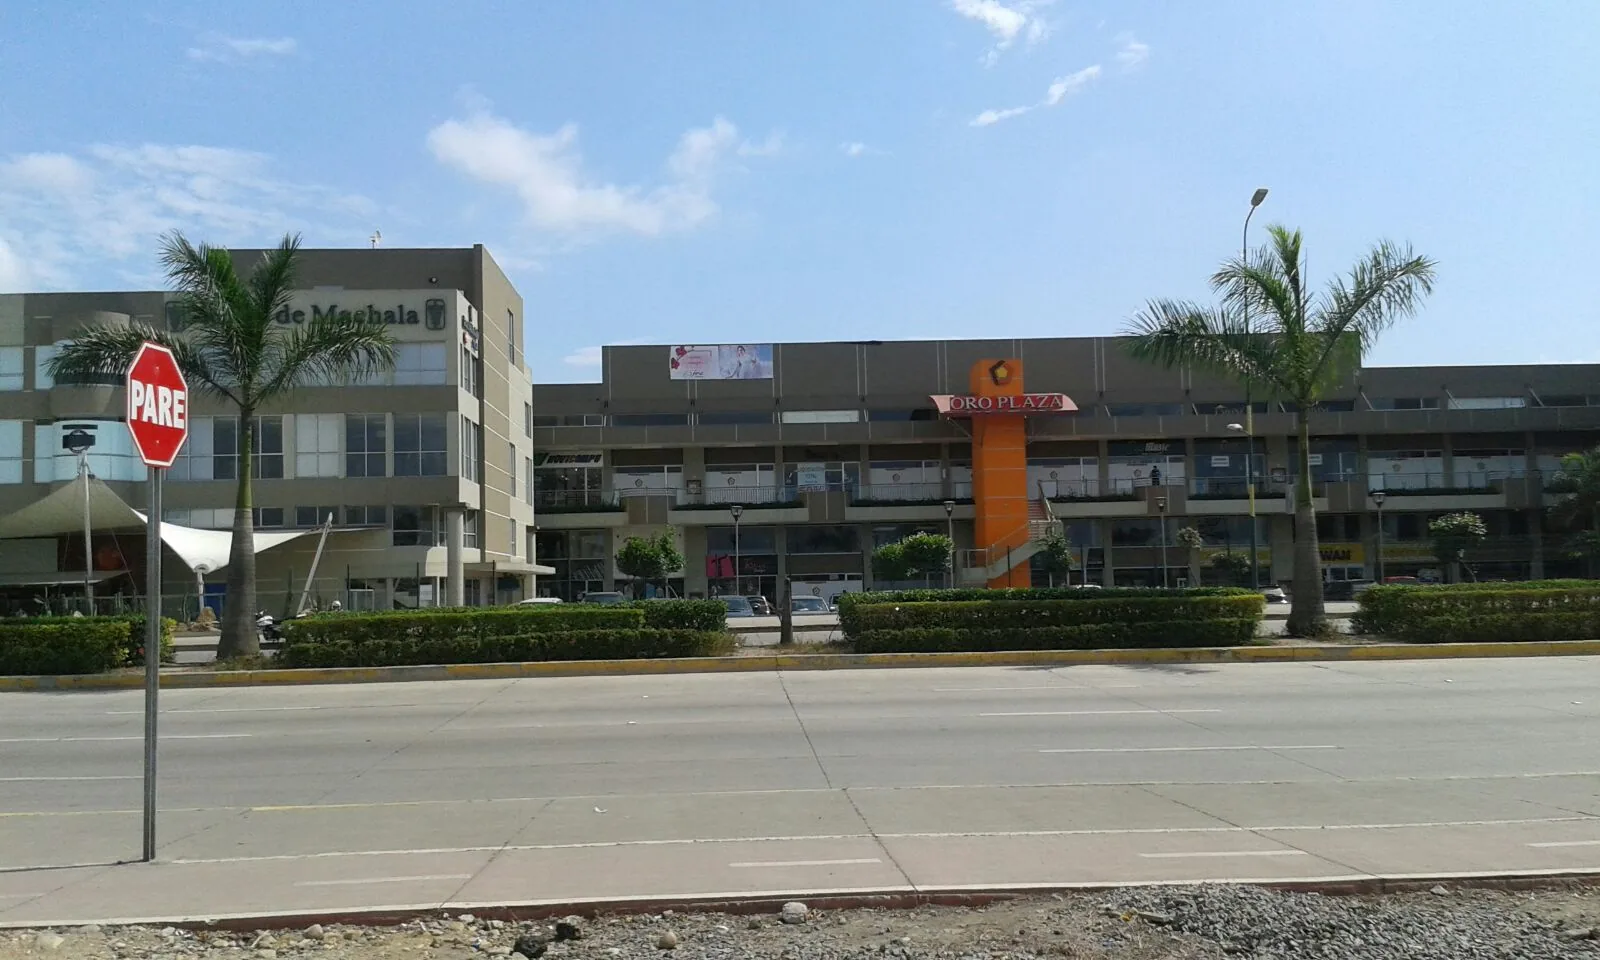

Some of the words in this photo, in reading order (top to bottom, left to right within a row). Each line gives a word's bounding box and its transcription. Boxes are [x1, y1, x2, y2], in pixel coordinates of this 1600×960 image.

[275, 304, 305, 324] de
[311, 304, 420, 325] Machala
[131, 379, 185, 429] PARE
[951, 396, 992, 410] ORO
[997, 395, 1062, 409] PLAZA
